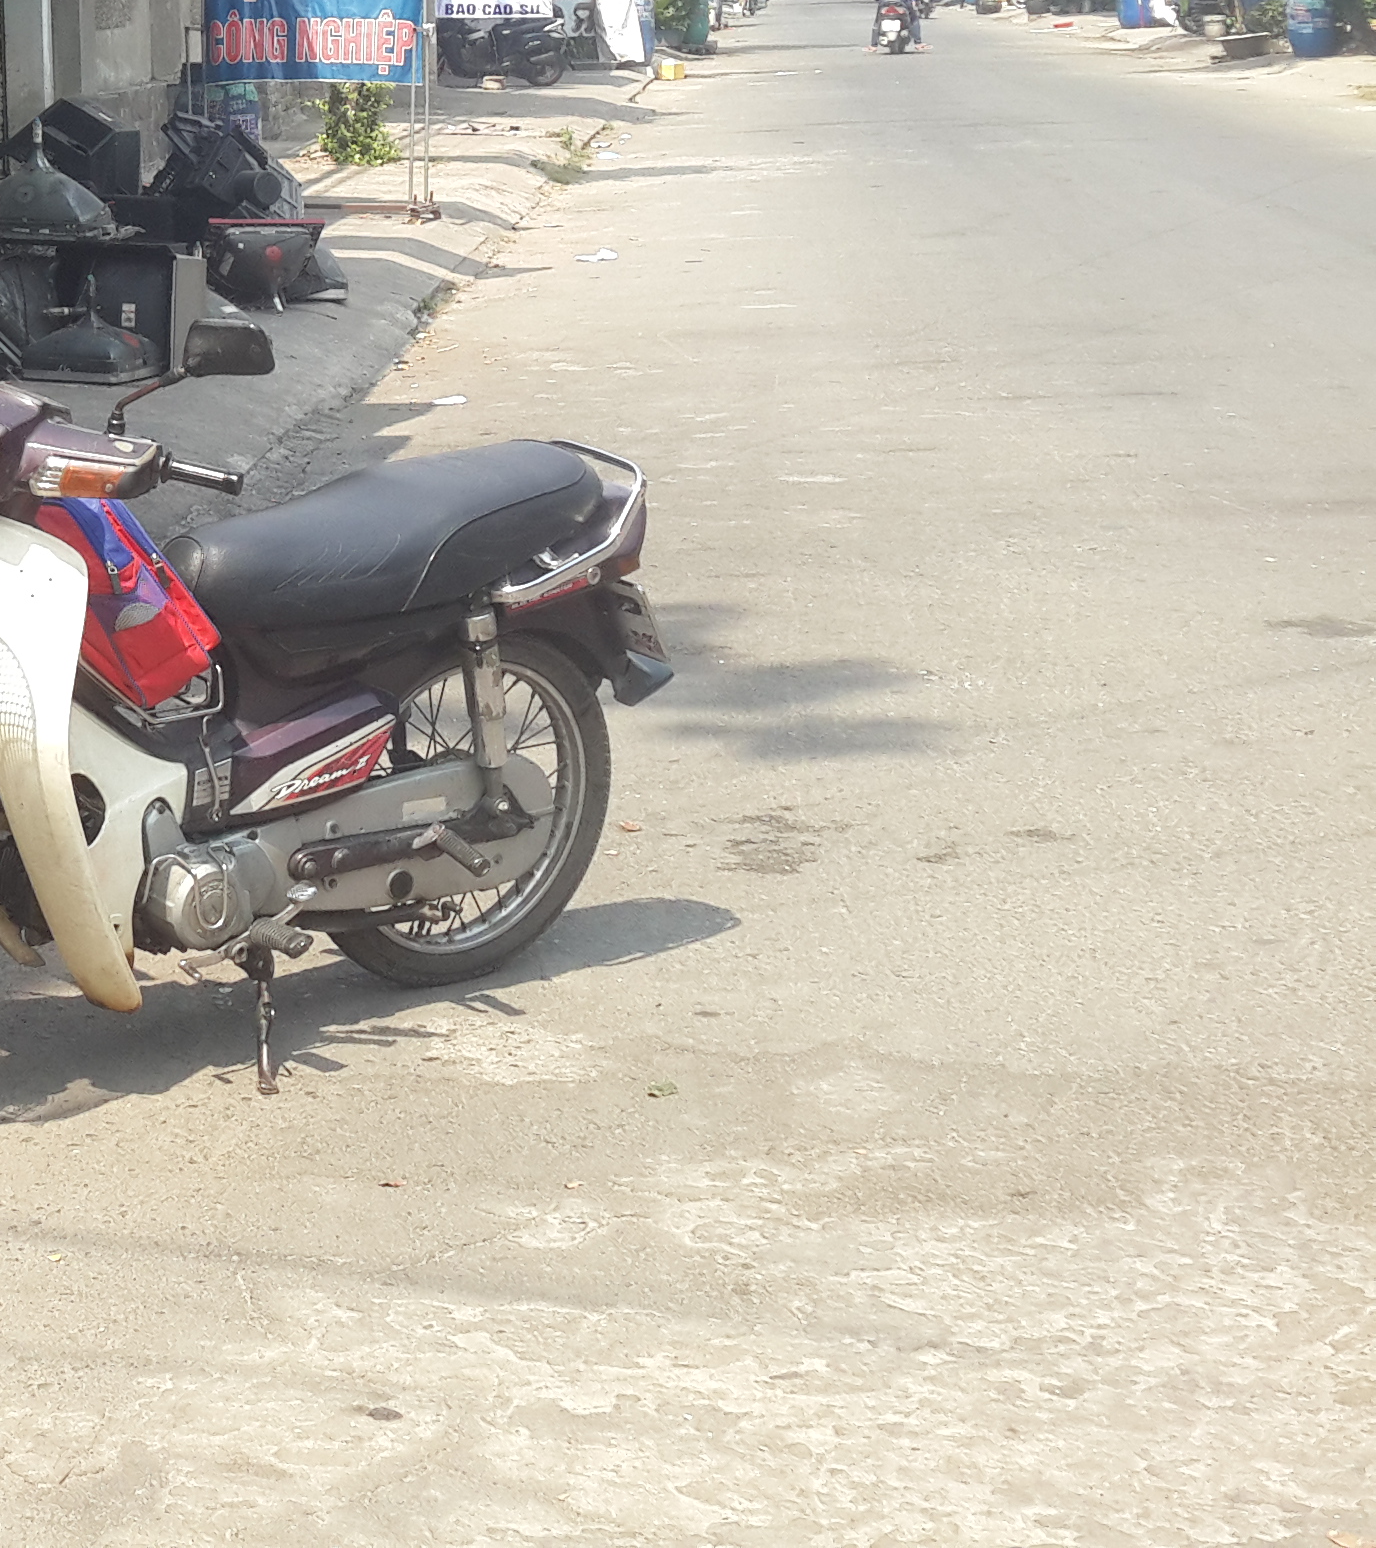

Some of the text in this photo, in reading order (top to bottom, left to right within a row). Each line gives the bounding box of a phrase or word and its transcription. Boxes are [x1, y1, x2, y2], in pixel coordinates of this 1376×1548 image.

[444, 3, 477, 16] BAO
[481, 3, 514, 16] CAO
[209, 9, 416, 75] CÔNG NGHIỆP
[270, 765, 351, 801] Dream
